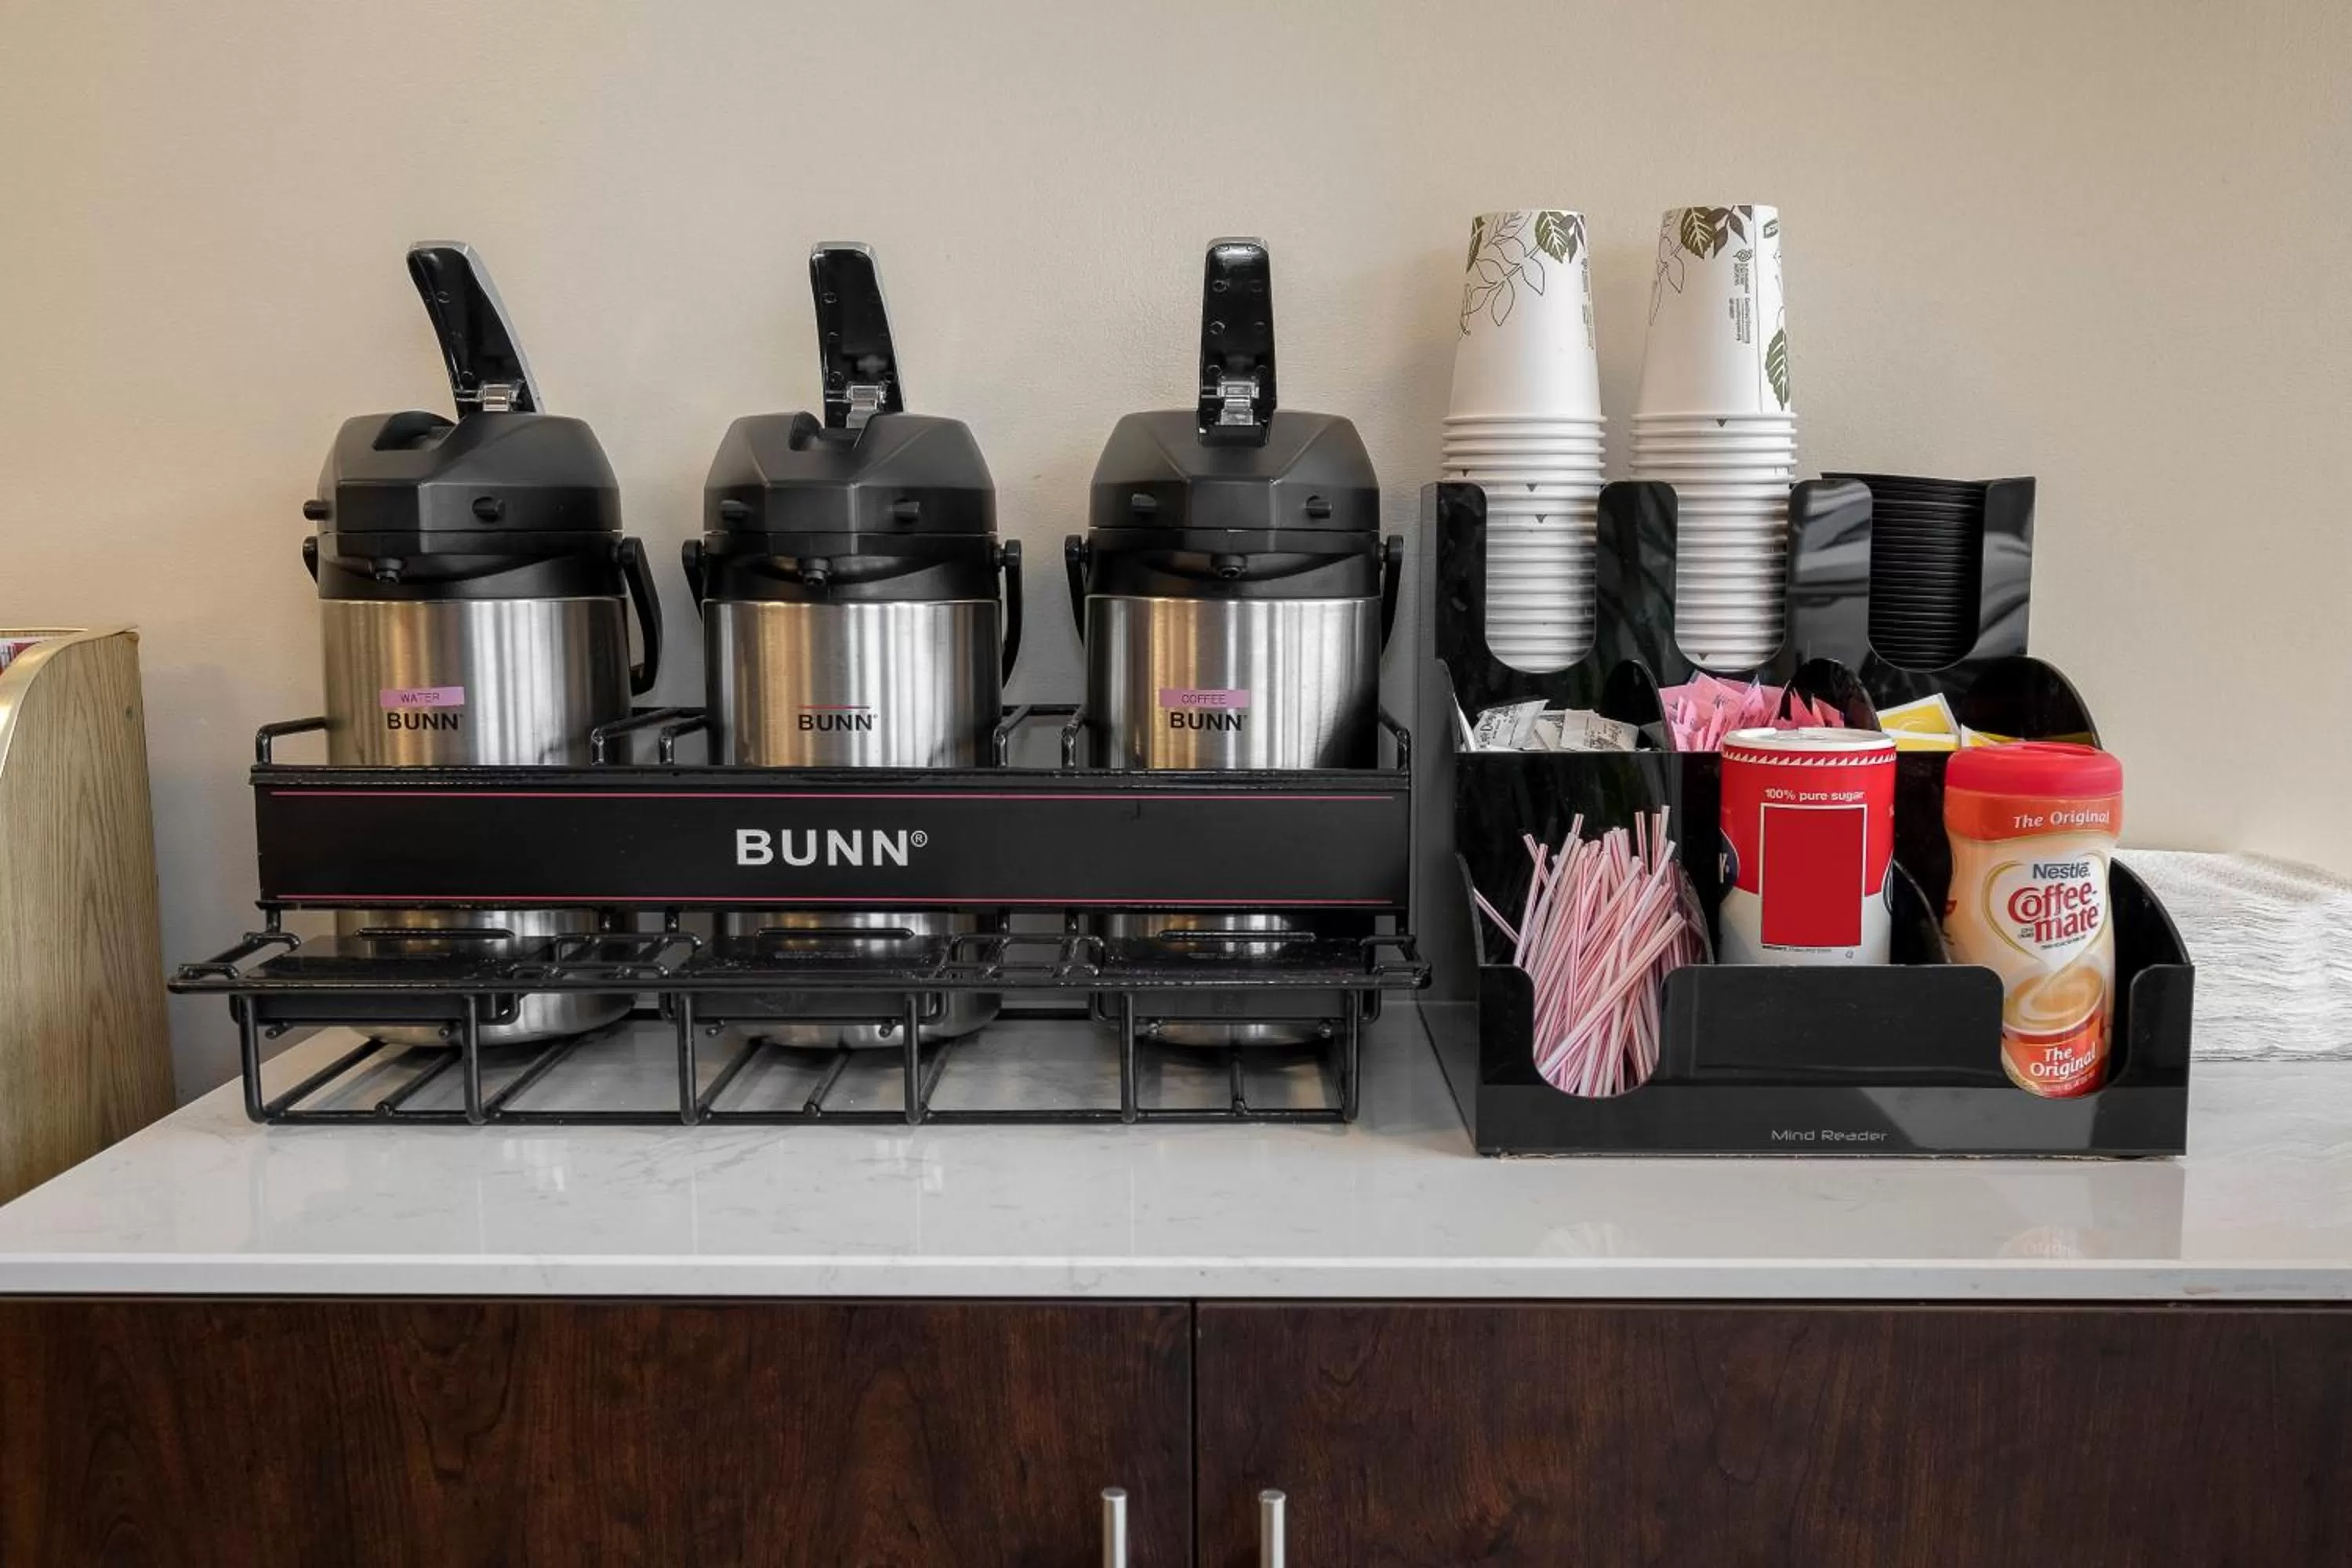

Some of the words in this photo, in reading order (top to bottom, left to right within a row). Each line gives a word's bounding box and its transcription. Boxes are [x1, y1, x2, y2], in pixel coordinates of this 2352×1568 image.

[401, 692, 440, 703] WATER
[1181, 694, 1226, 704] COFFEE
[387, 713, 458, 729] BUNN
[798, 714, 872, 731] BUNN
[1171, 712, 1242, 731] BUNN
[1765, 788, 1795, 800] 100%
[1799, 791, 1828, 801] pure
[1831, 791, 1864, 802] sugar
[2013, 815, 2044, 828] The
[2050, 809, 2110, 826] Original
[2034, 906, 2099, 942] mate
[2030, 1041, 2096, 1079] Original
[2044, 1047, 2072, 1062] The
[1772, 1129, 1815, 1141] Mind
[1821, 1130, 1888, 1142] Reader
